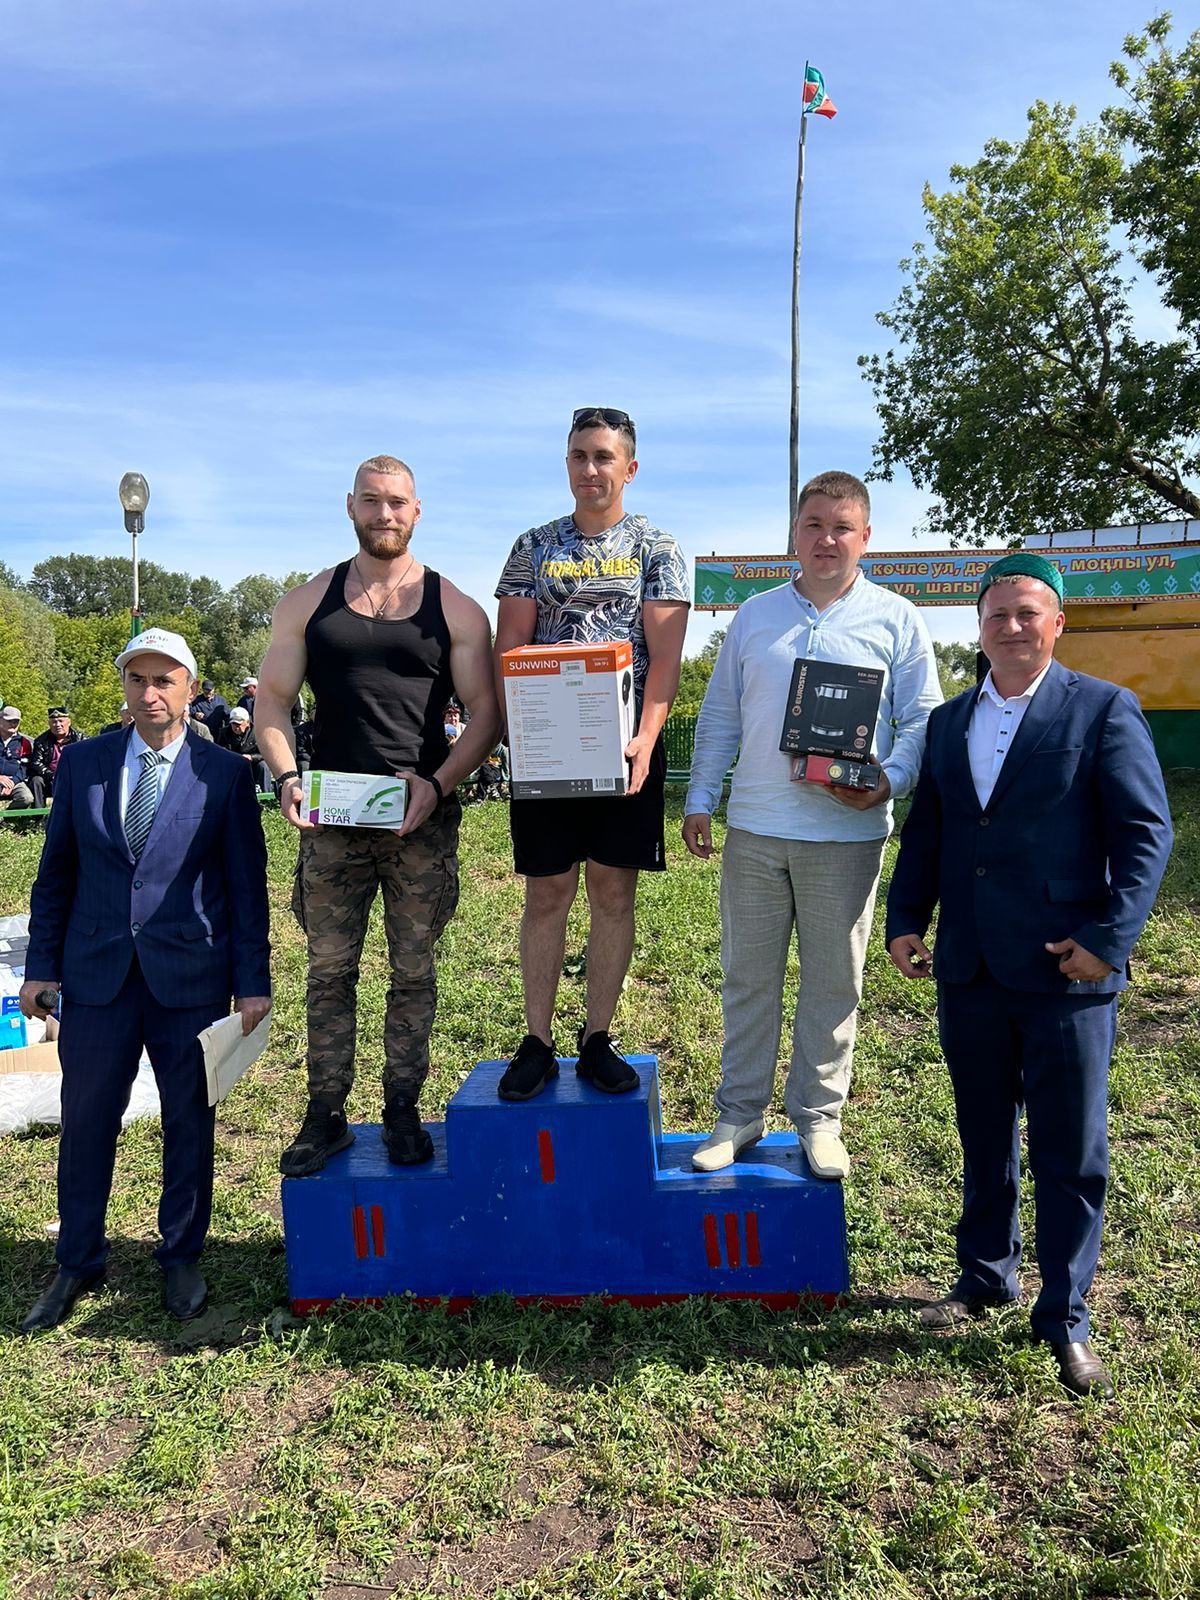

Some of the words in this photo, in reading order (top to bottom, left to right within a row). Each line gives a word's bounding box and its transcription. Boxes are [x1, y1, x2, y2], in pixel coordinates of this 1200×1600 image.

[732, 563, 792, 580] Халык
[872, 562, 928, 576] көчле
[930, 561, 961, 578] ул,
[1071, 557, 1141, 573] моңлы
[1145, 553, 1177, 573] ул,
[508, 659, 559, 671] SUNWIND
[795, 664, 808, 704] EUROSTEK
[323, 807, 351, 816] HOME
[323, 814, 351, 824] STAR
